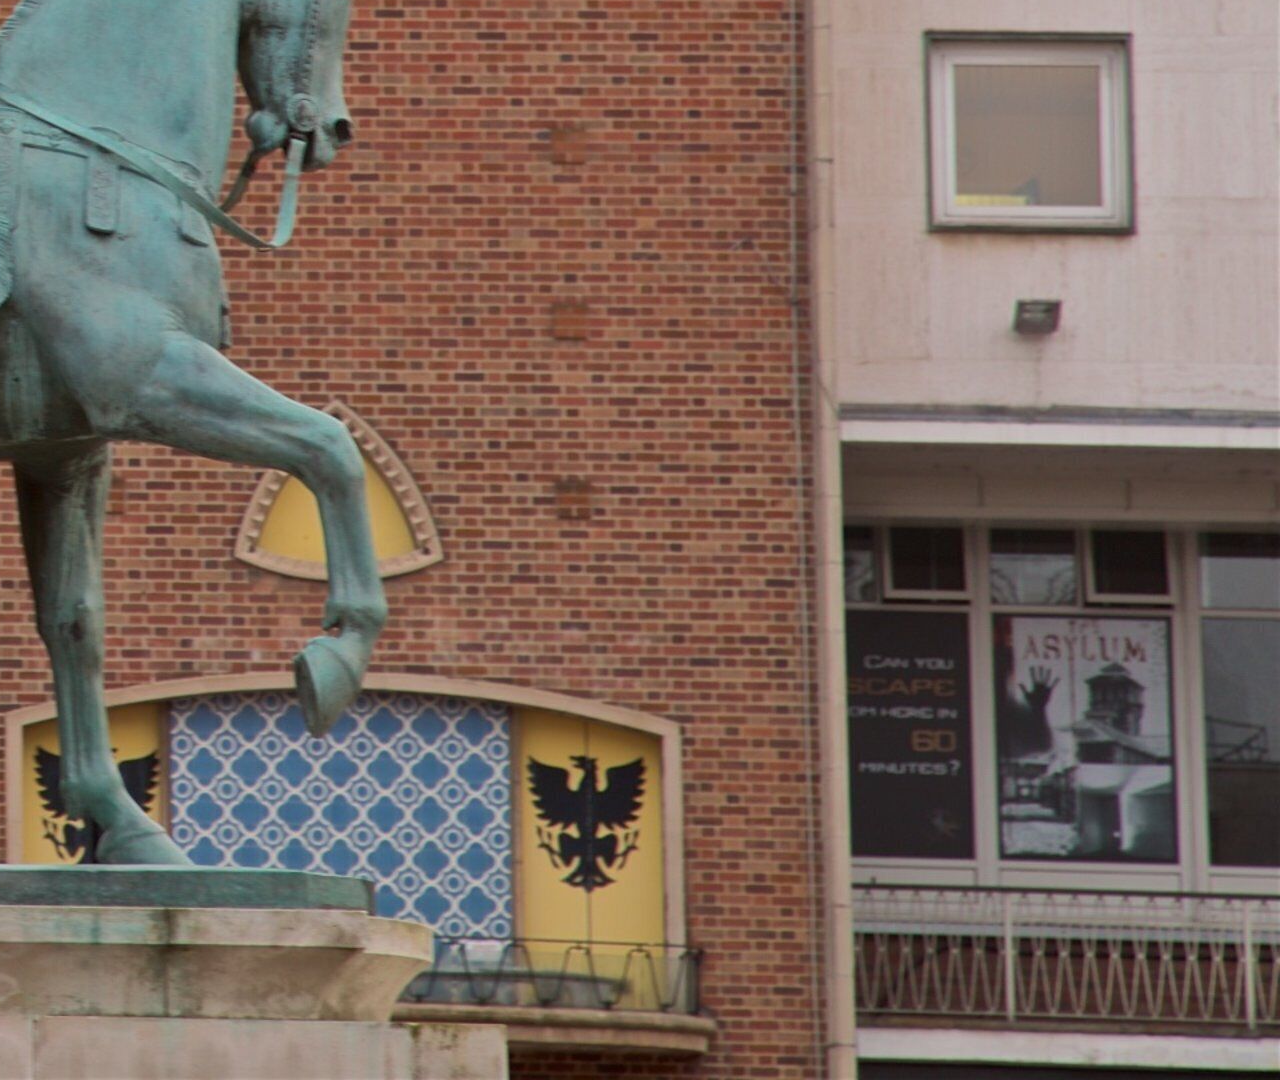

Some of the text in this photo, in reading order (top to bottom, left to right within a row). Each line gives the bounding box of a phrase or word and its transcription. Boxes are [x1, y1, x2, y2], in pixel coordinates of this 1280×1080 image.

[1023, 634, 1147, 662] ASYLUM
[862, 654, 955, 671] CAN YOU
[848, 677, 957, 697] SCAPE
[848, 705, 877, 718] OM
[911, 728, 957, 752] 60
[858, 759, 961, 776] MINUTES?
